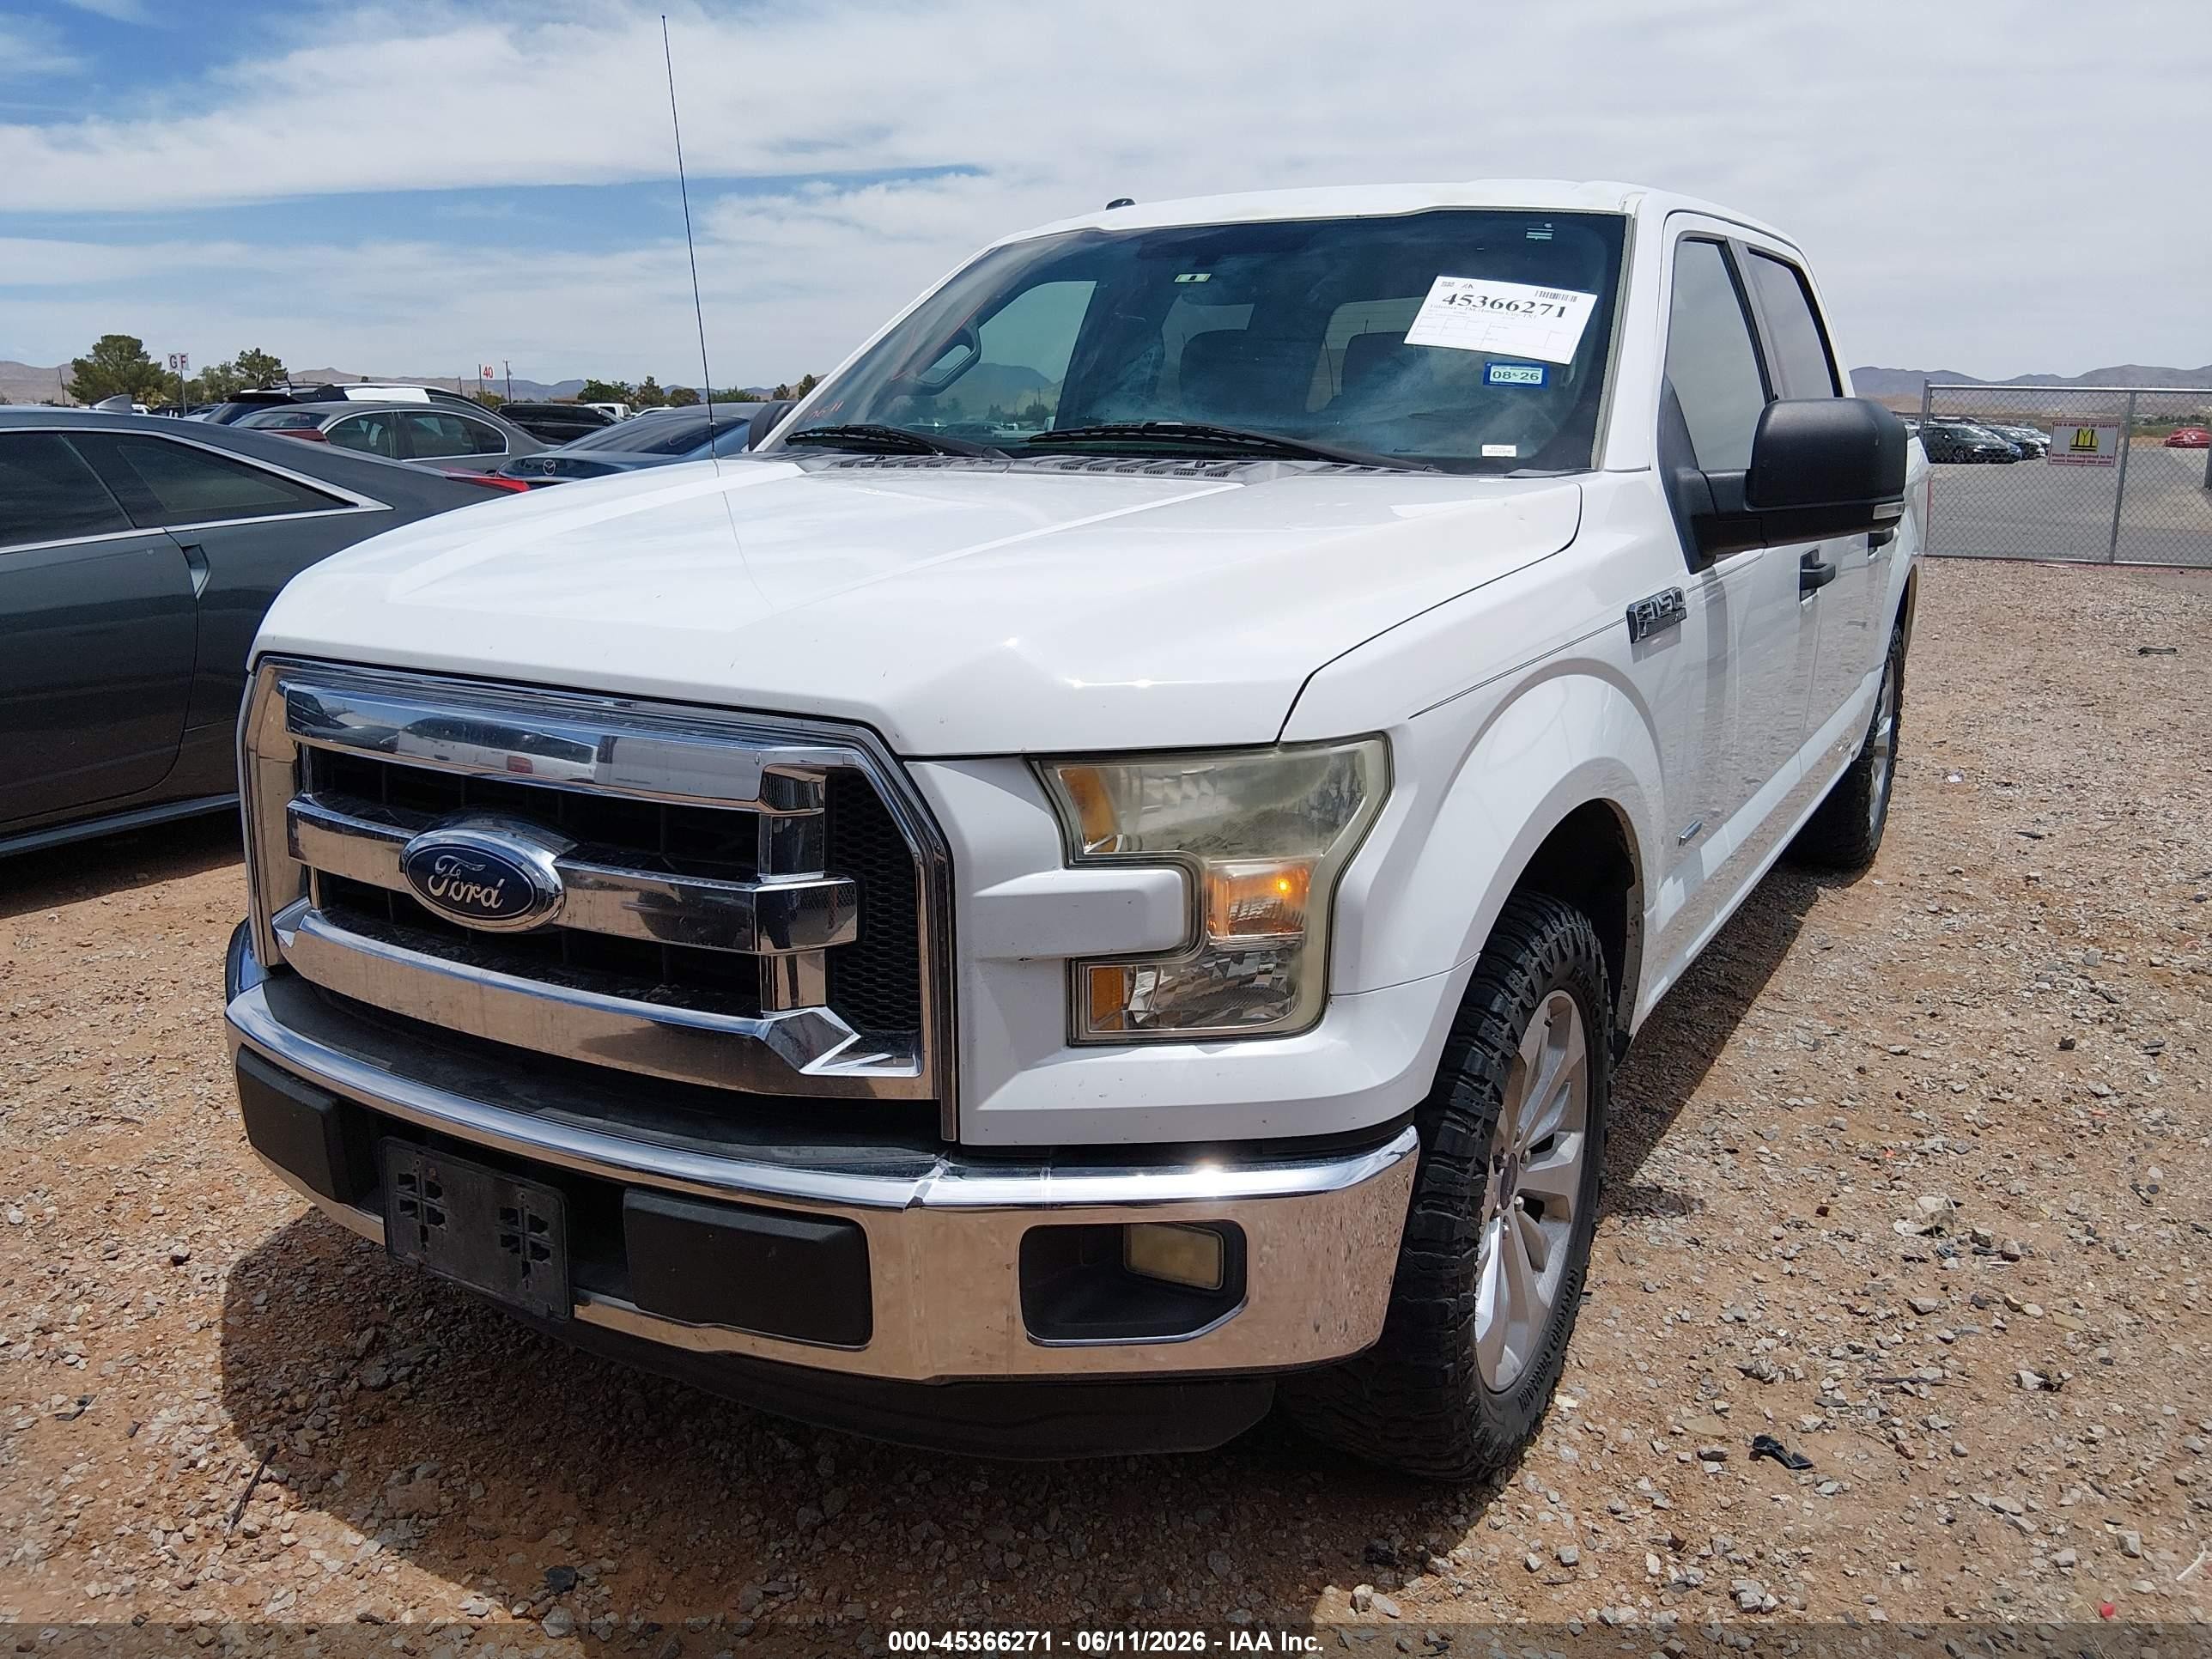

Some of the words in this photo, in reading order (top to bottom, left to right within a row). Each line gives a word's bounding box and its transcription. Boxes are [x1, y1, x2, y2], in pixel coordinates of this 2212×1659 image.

[1442, 293, 1566, 318] 45366271
[483, 367, 493, 378] 40
[1492, 370, 1512, 380] 08
[1519, 372, 1540, 381] 26
[428, 854, 506, 908] Ford
